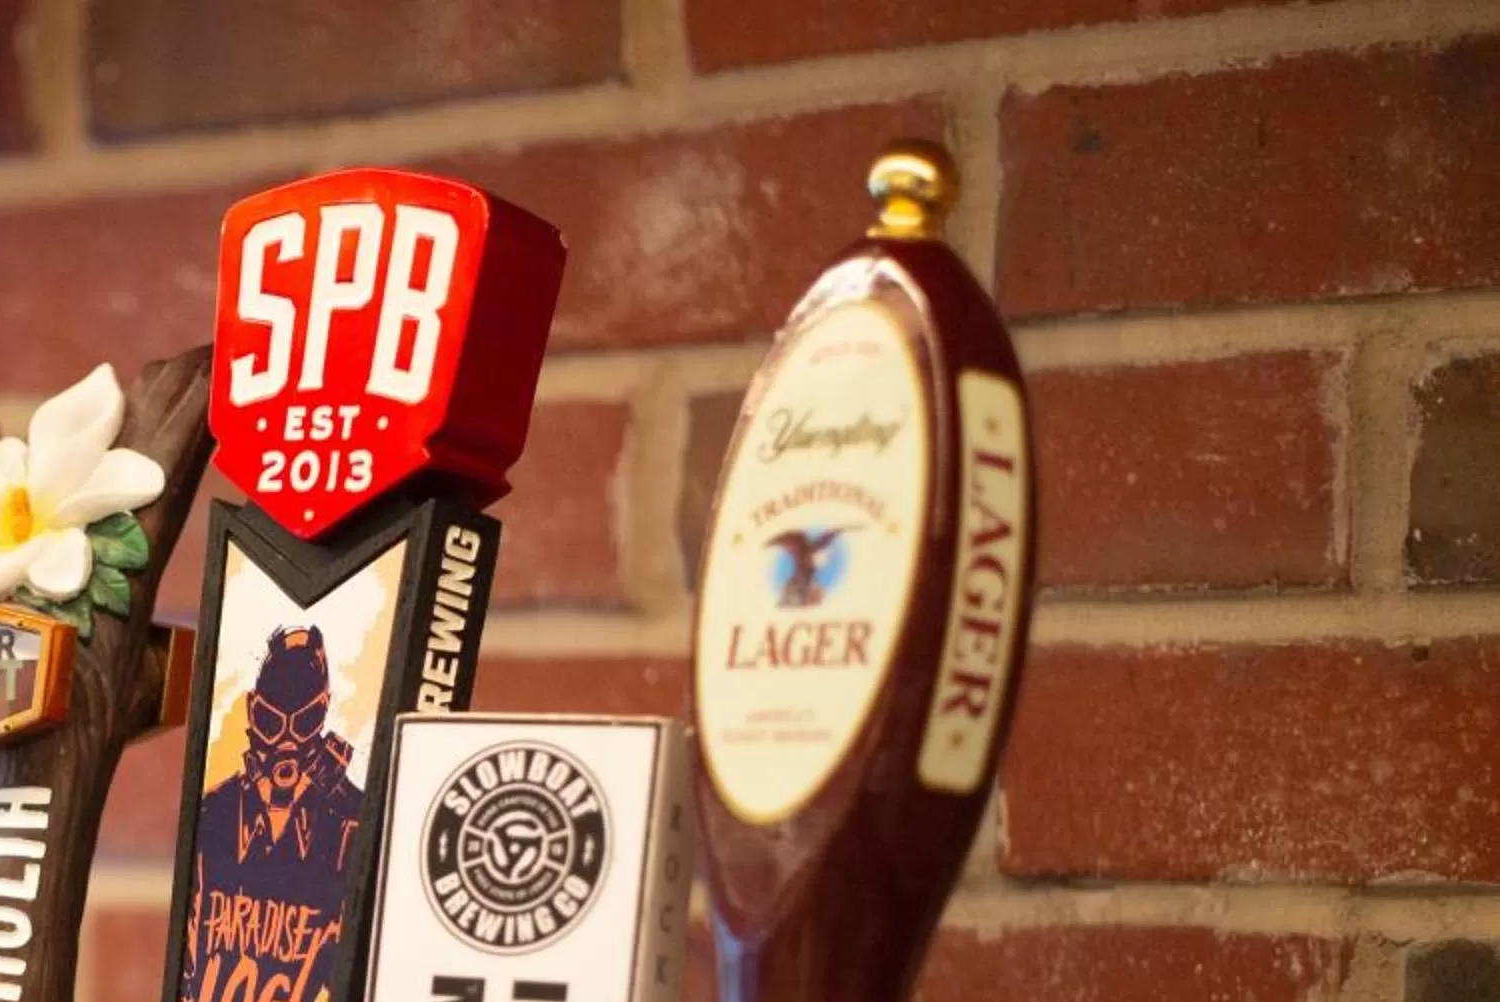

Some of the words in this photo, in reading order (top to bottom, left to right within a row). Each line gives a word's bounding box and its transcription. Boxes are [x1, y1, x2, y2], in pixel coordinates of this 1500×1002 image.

[229, 202, 460, 408] SPB
[283, 405, 361, 441] EST
[256, 449, 374, 492] 2013
[417, 524, 483, 713] REWING
[942, 448, 1016, 720] LAGER
[725, 620, 875, 671] LAGER
[443, 748, 601, 819] SLOWBOAT
[204, 886, 321, 964] PARADISE
[434, 872, 557, 945] BREWING
[552, 874, 591, 918] CO
